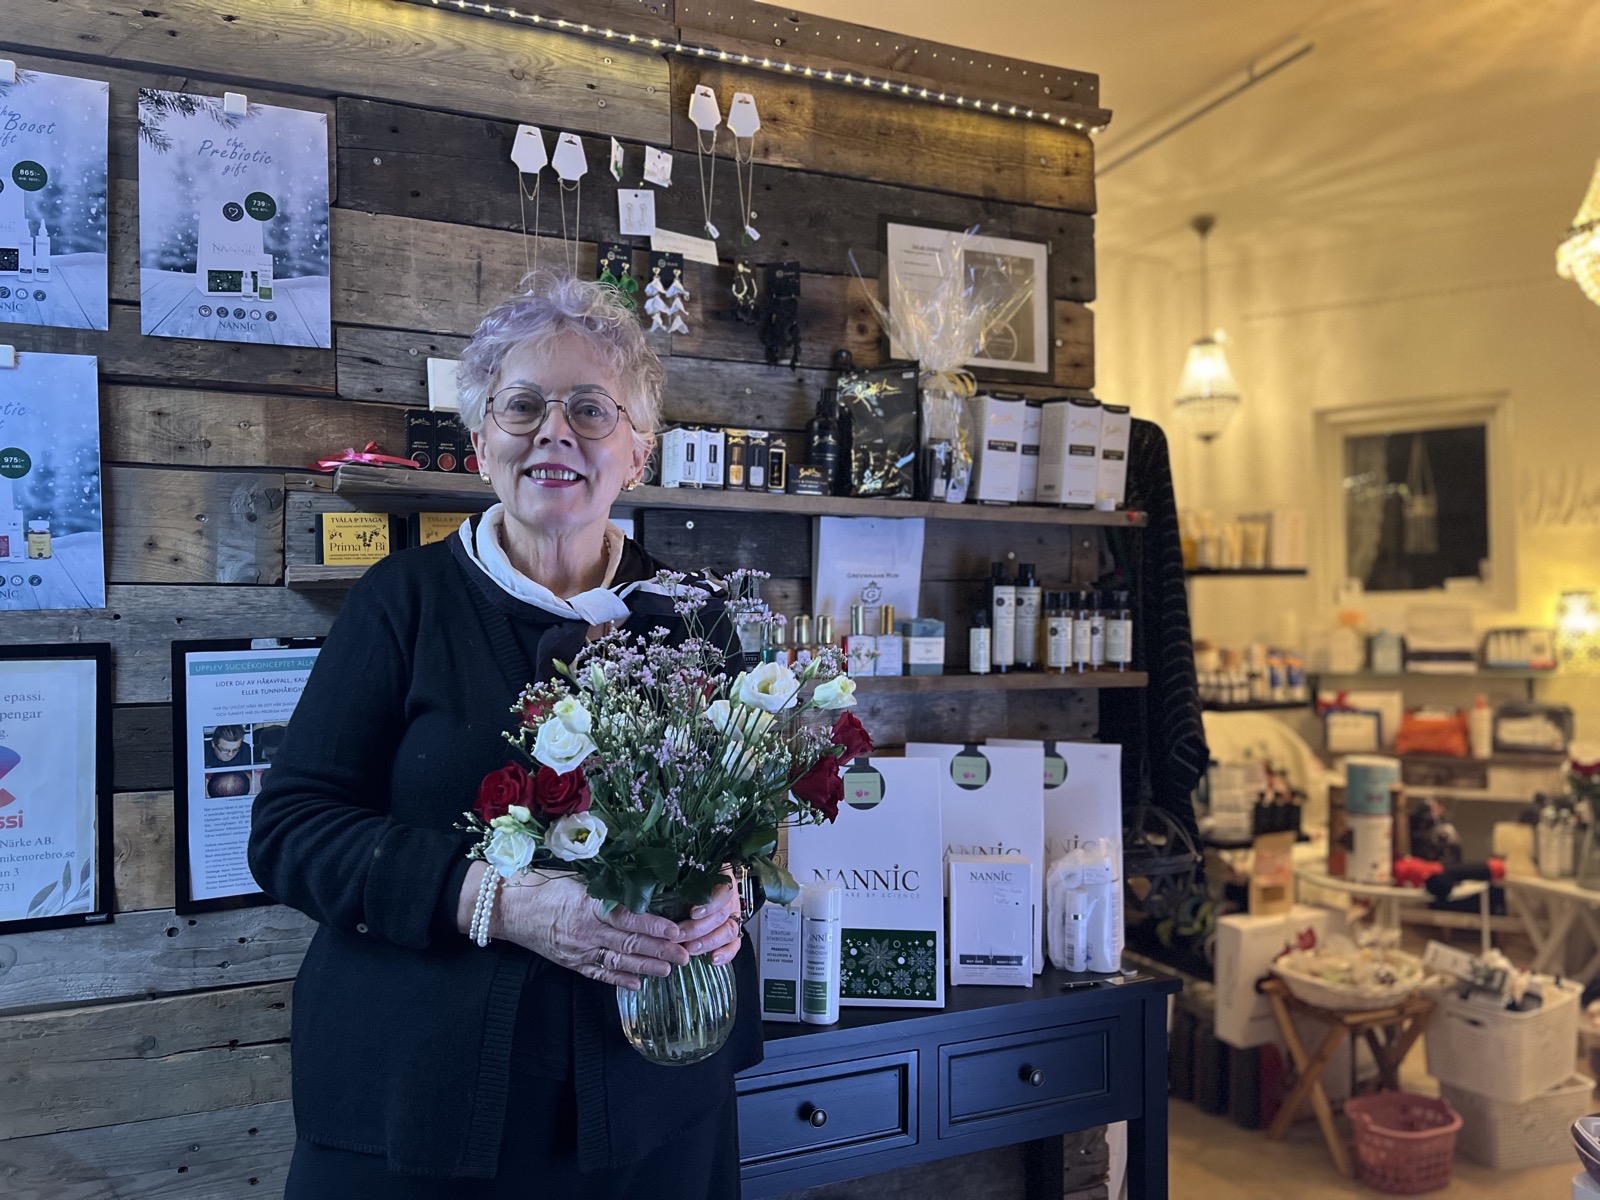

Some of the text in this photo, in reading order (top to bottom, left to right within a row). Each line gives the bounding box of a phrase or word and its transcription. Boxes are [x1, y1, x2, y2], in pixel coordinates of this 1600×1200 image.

[4, 113, 56, 134] Boost
[226, 137, 244, 148] the
[198, 139, 272, 164] Prebiotic
[222, 162, 248, 177] gift
[219, 319, 257, 332] NANNIC
[330, 542, 385, 552] Prima Bi
[195, 664, 223, 673] UPPLEV
[215, 680, 234, 688] LIDER
[3, 690, 45, 704] epassi.
[261, 687, 305, 695] TUNNHÅRIGH
[0, 710, 43, 722] pengar
[0, 836, 55, 849] Närke AB.
[13, 867, 20, 877] 3
[811, 863, 920, 892] NANNIC
[969, 870, 1012, 882] NANNIC
